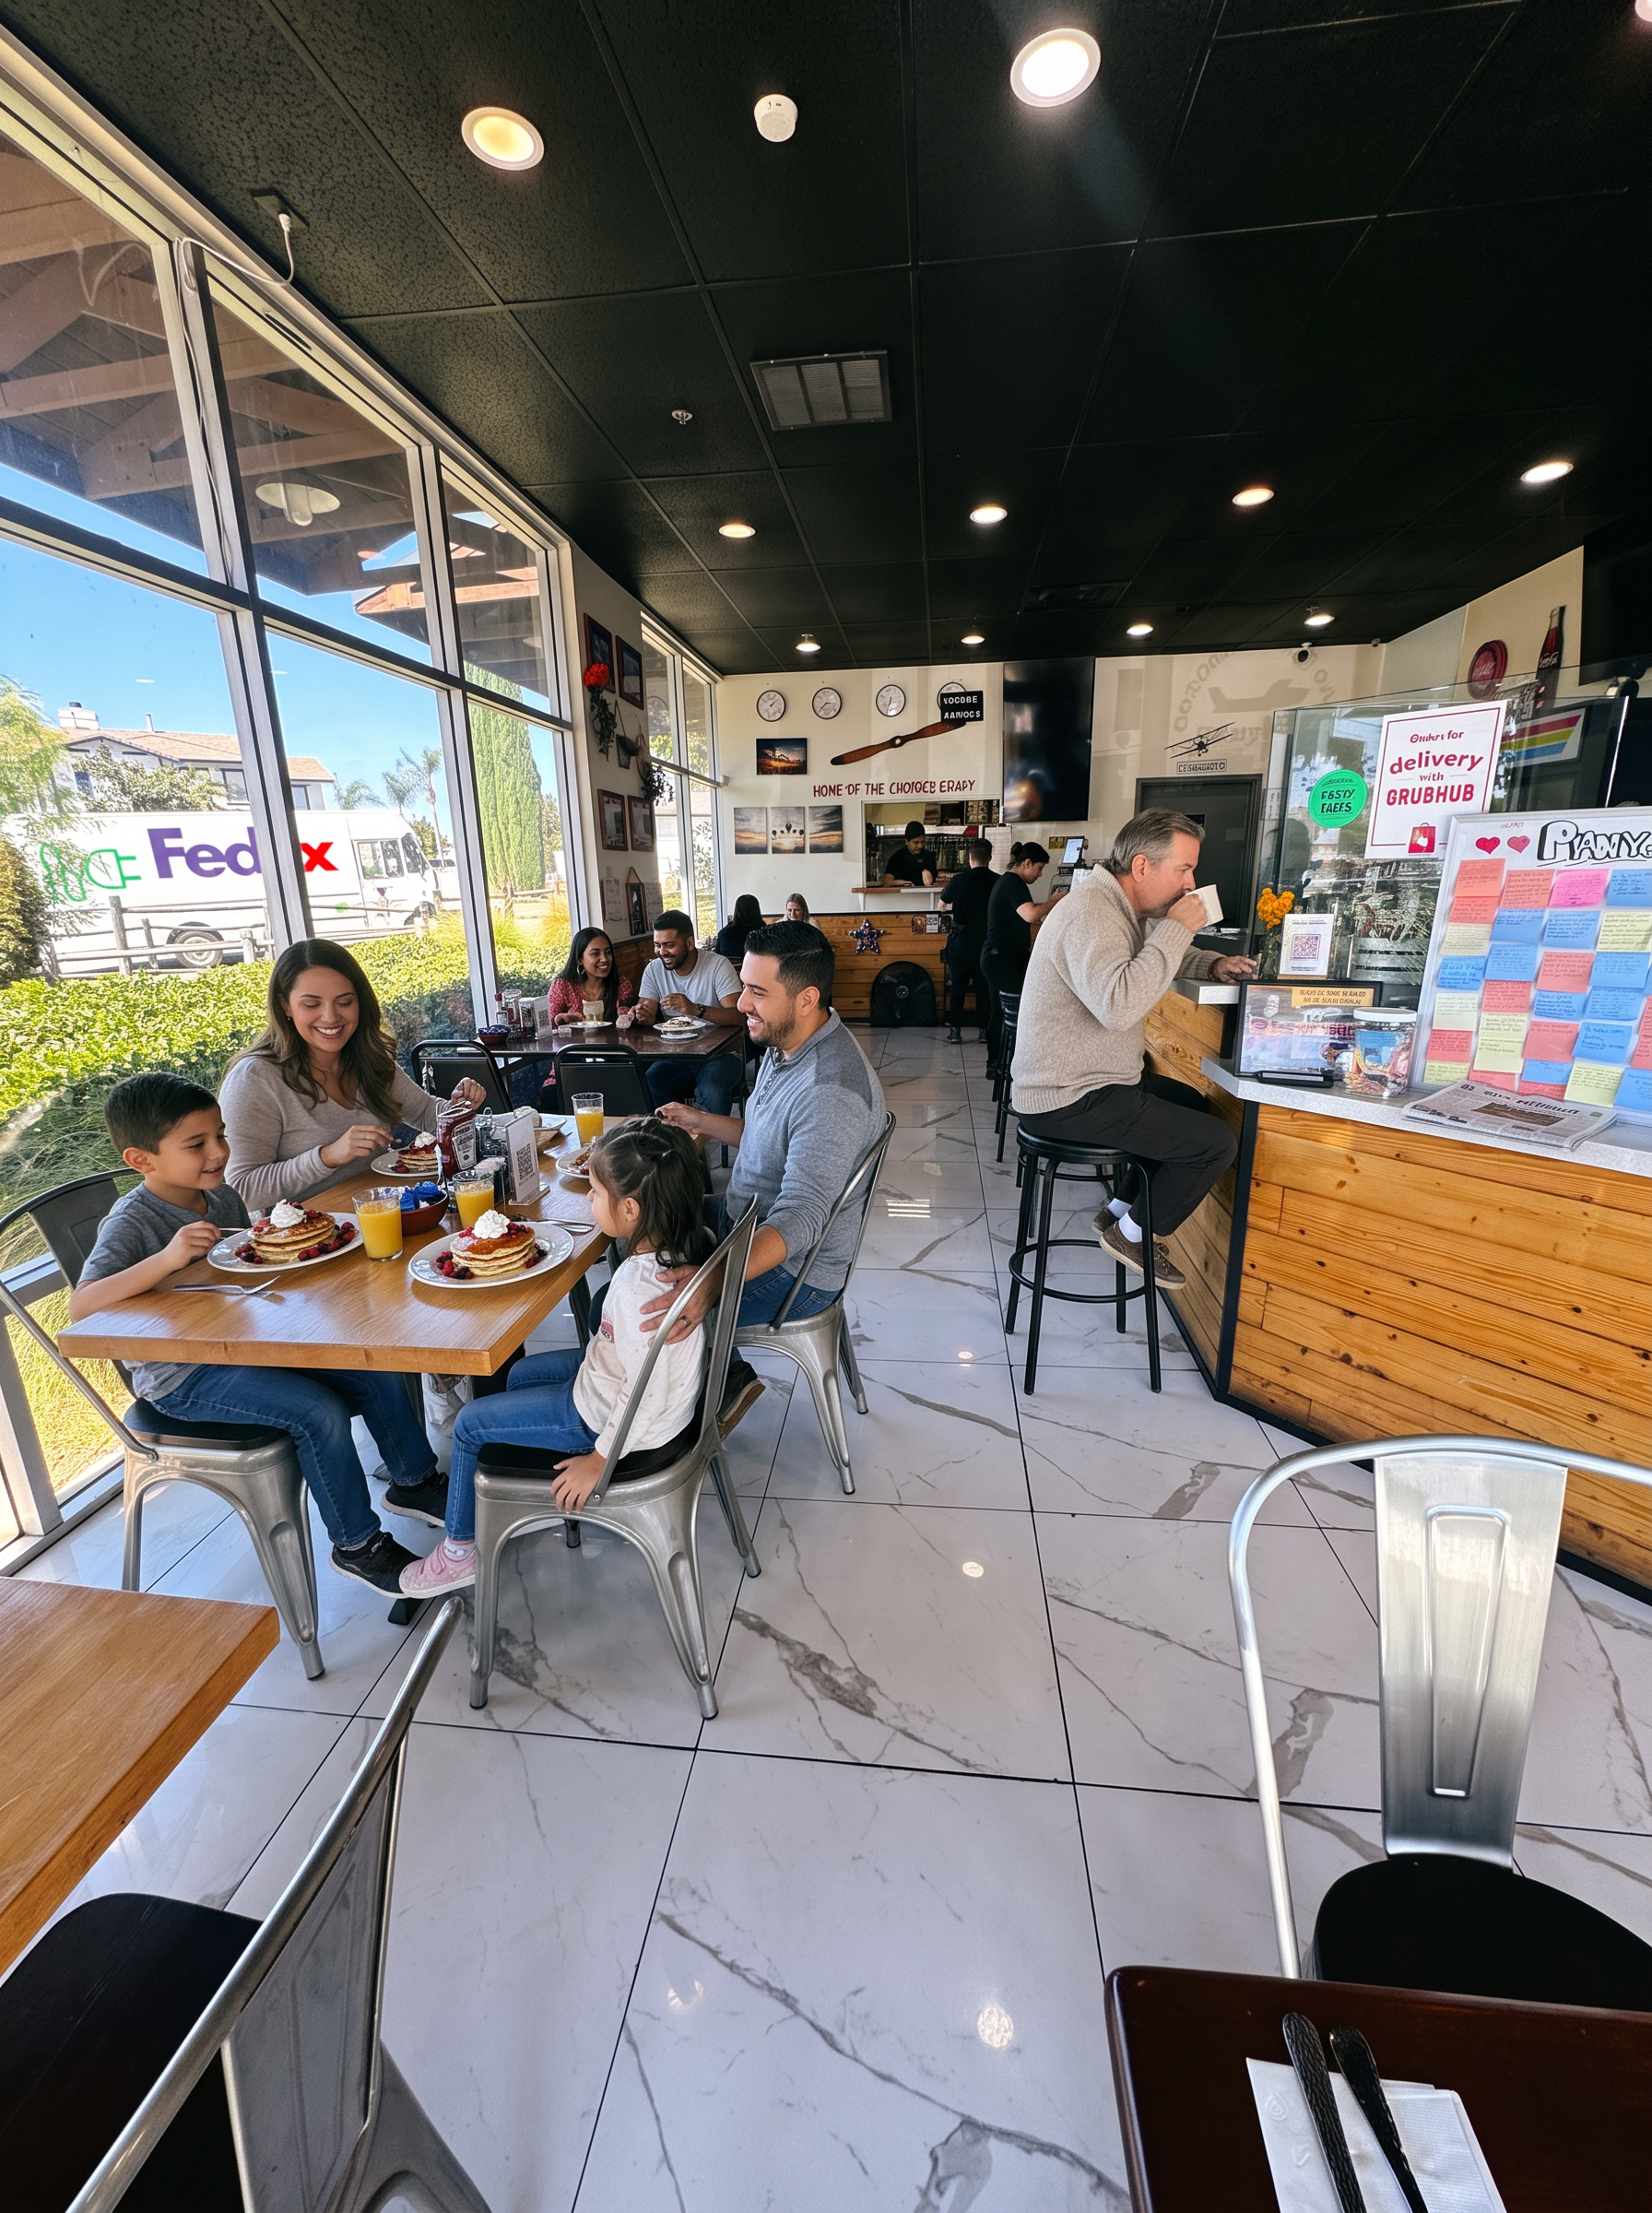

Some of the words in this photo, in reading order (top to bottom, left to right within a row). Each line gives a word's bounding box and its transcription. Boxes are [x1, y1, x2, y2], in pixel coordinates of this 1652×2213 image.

[1447, 729, 1465, 740] for
[1389, 751, 1484, 775] delivery
[1420, 771, 1445, 782] with
[865, 782, 886, 796] THE
[1386, 784, 1475, 806] GRUBHUB
[147, 826, 339, 879] Fedx
